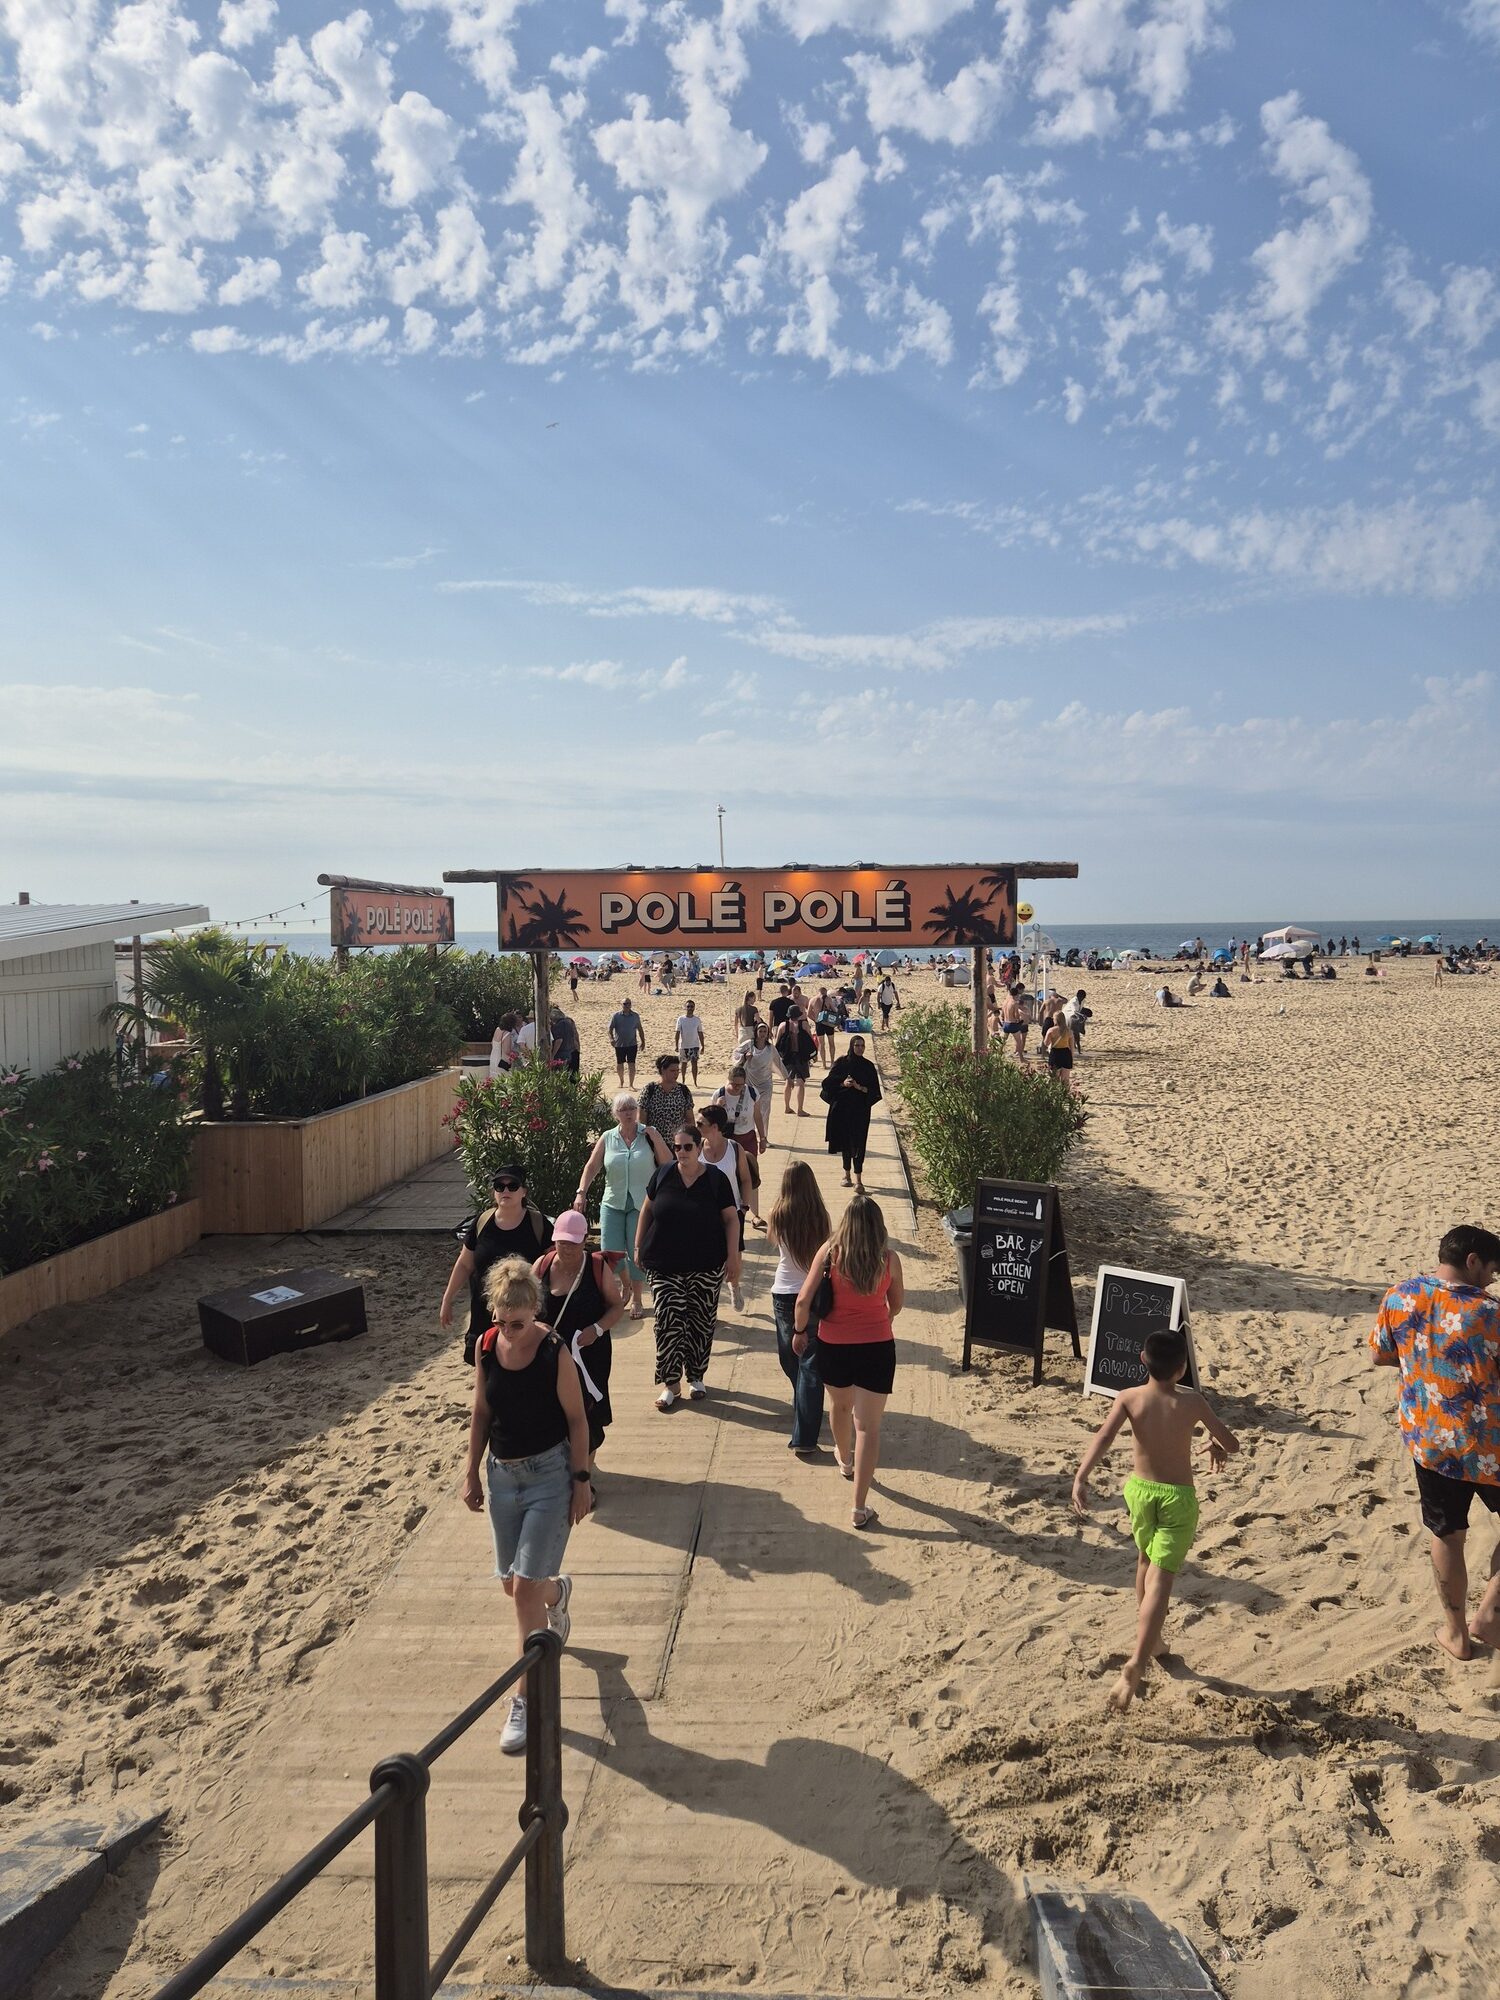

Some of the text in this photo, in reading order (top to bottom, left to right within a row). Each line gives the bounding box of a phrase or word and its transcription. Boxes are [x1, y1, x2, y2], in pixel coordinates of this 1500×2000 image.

[599, 879, 912, 934] POLÉ POLÉ
[366, 901, 434, 934] POLÉ POLÉ
[995, 1234, 1026, 1251] BAR
[1007, 1250, 1016, 1262] &
[991, 1262, 1032, 1280] KITCHEN
[997, 1279, 1025, 1295] OPEN
